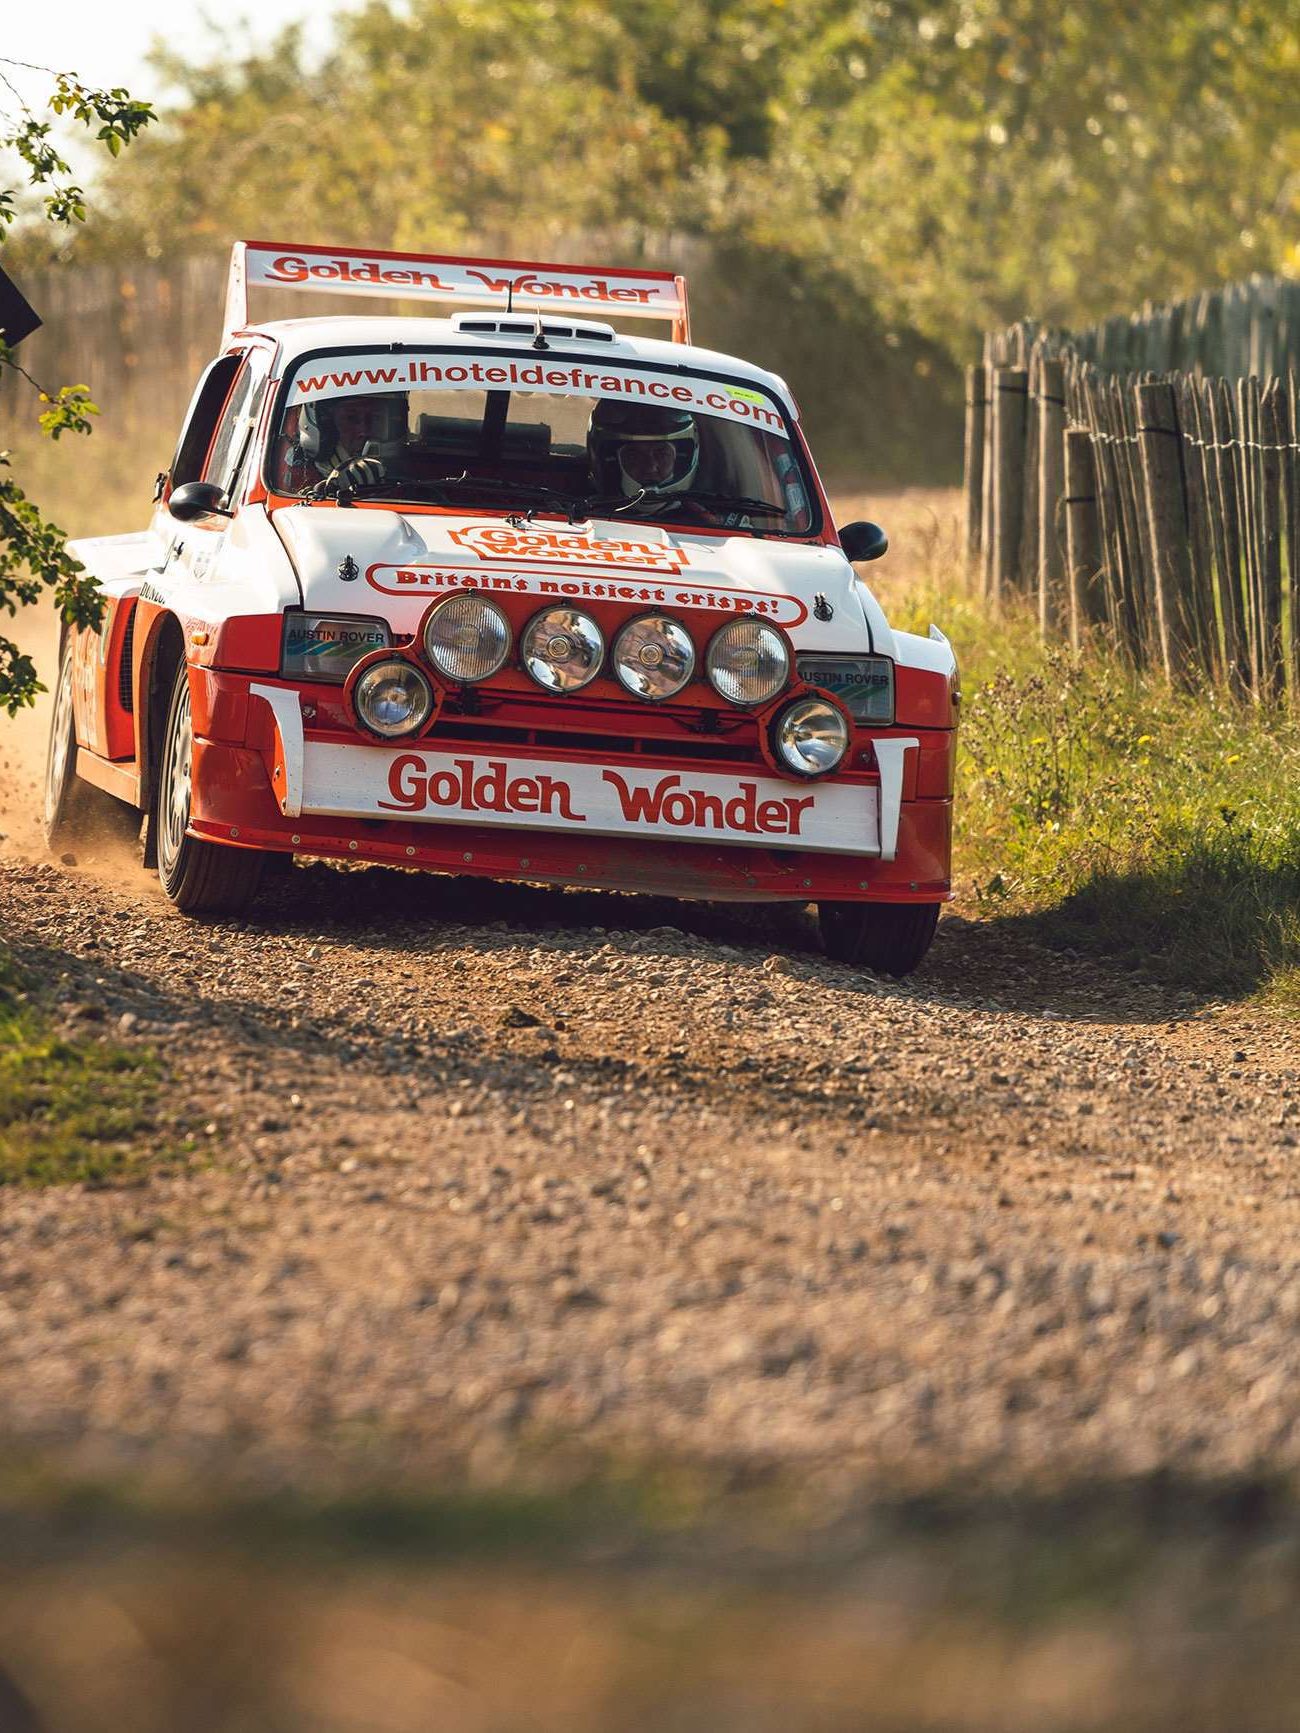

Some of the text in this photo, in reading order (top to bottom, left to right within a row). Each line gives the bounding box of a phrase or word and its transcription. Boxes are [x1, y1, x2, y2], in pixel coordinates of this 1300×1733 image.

[264, 256, 660, 303] Golden Wonder
[296, 362, 785, 430] www.lhoteldefrance.com
[480, 529, 666, 555] Golden
[539, 580, 666, 602] noisiest
[675, 592, 780, 615] crisps!
[288, 629, 385, 643] AUSTIN ROVER
[845, 673, 889, 686] ROVER
[377, 754, 815, 835] Golden Wonder
